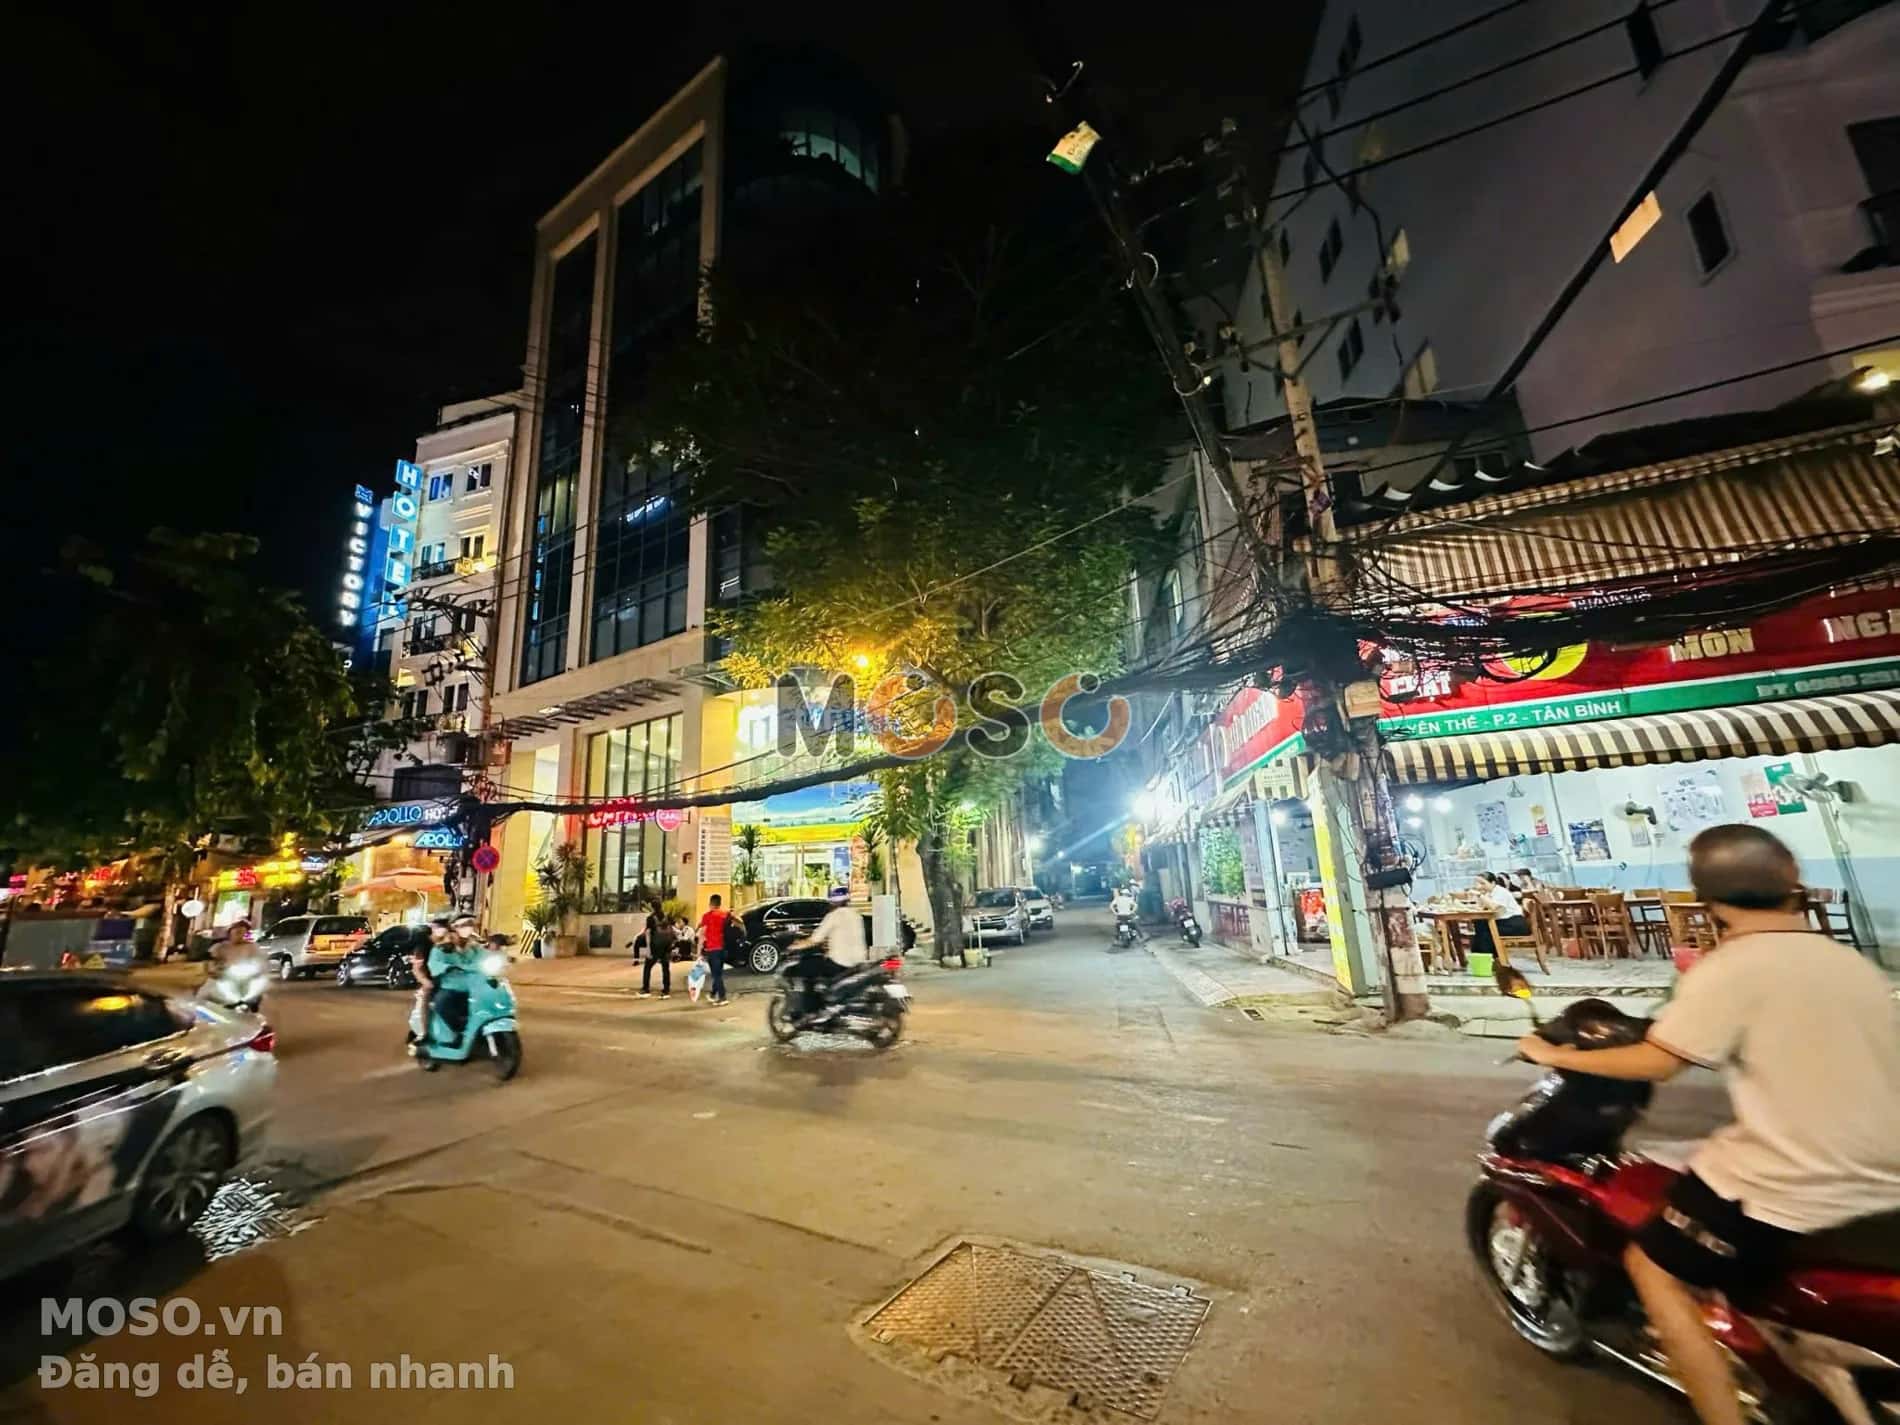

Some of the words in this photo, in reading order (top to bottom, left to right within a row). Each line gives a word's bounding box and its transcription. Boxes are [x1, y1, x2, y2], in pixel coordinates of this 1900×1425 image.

[385, 461, 420, 619] HOTEL
[1492, 712, 1518, 727] P.2
[1532, 705, 1571, 722] TÂN
[1574, 700, 1621, 717] BÌNH
